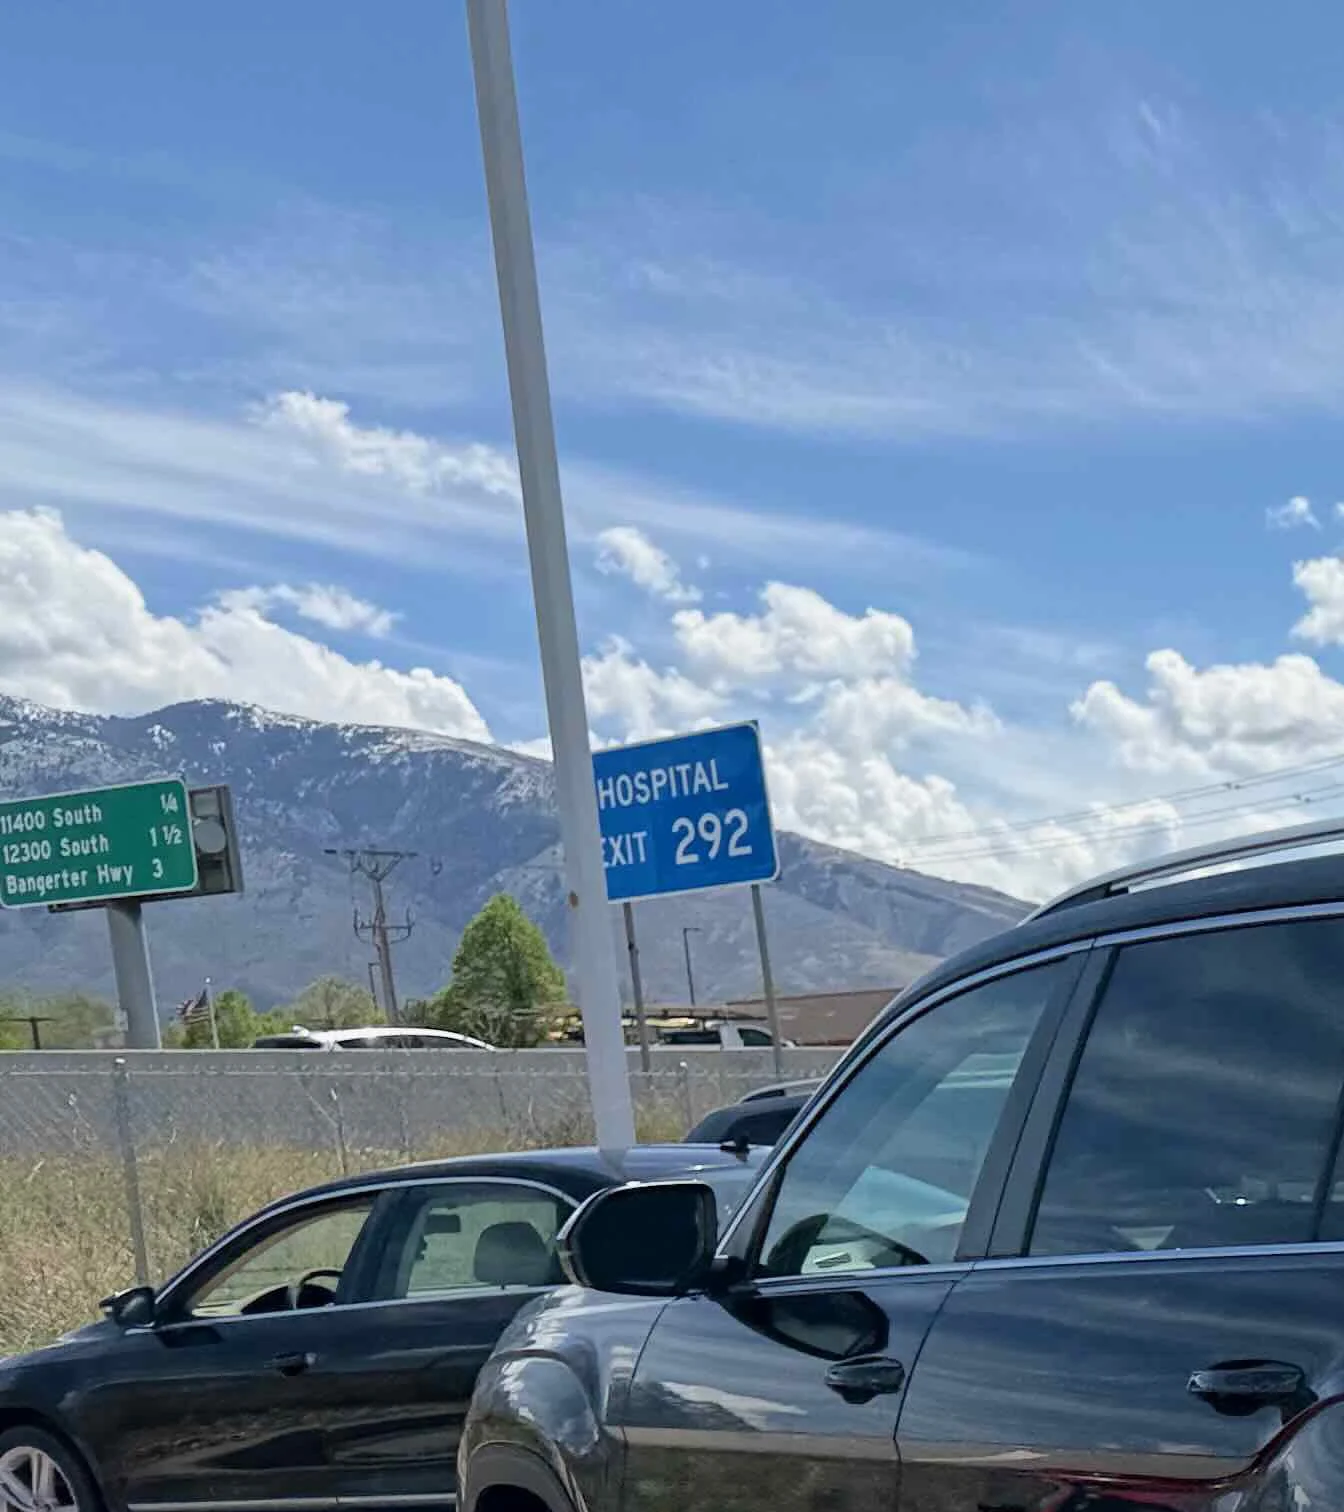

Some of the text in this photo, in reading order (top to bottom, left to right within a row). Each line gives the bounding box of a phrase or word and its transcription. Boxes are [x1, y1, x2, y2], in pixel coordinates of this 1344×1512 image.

[598, 759, 728, 810] HOSPITAL
[0, 810, 46, 834] 11400
[53, 805, 102, 828] South
[671, 808, 753, 865] 292
[3, 839, 51, 864] 12300
[59, 834, 109, 857] South
[149, 827, 157, 847] 1
[6, 858, 163, 896] Bangerter Hwy 3
